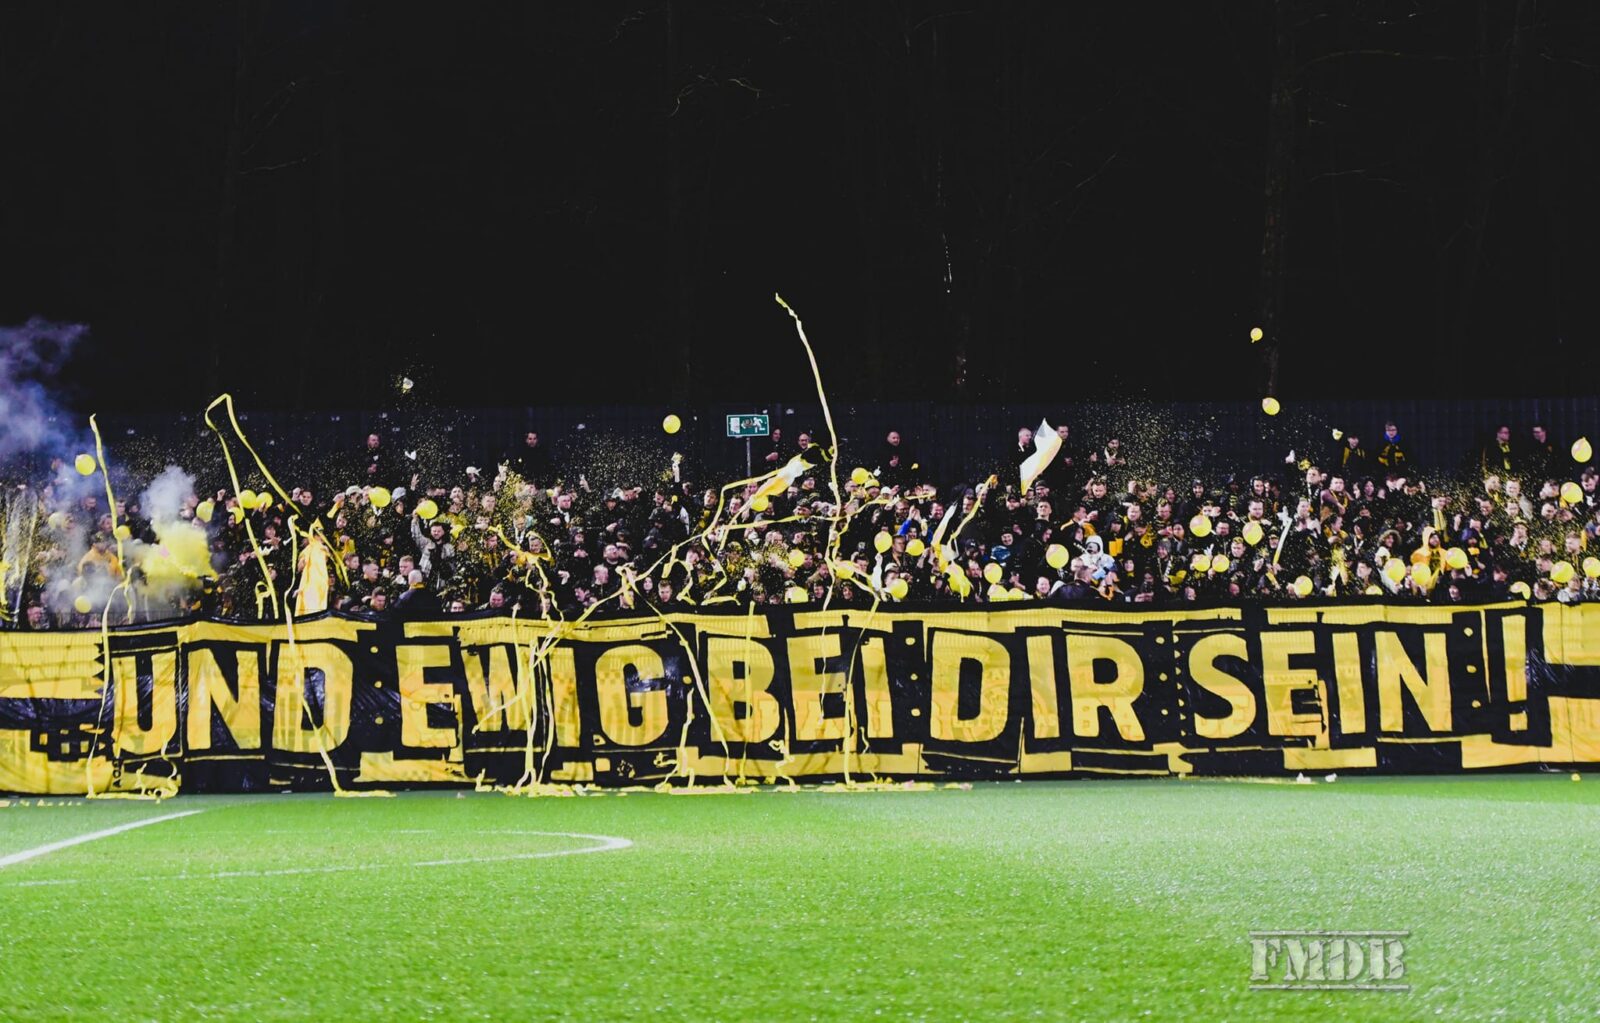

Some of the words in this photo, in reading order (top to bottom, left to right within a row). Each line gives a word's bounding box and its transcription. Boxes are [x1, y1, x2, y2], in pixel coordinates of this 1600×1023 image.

[111, 642, 354, 755] UND
[395, 644, 669, 748] EWIG
[707, 634, 894, 743] BEI
[930, 631, 1145, 743] DIR
[1188, 630, 1453, 739] SEIN
